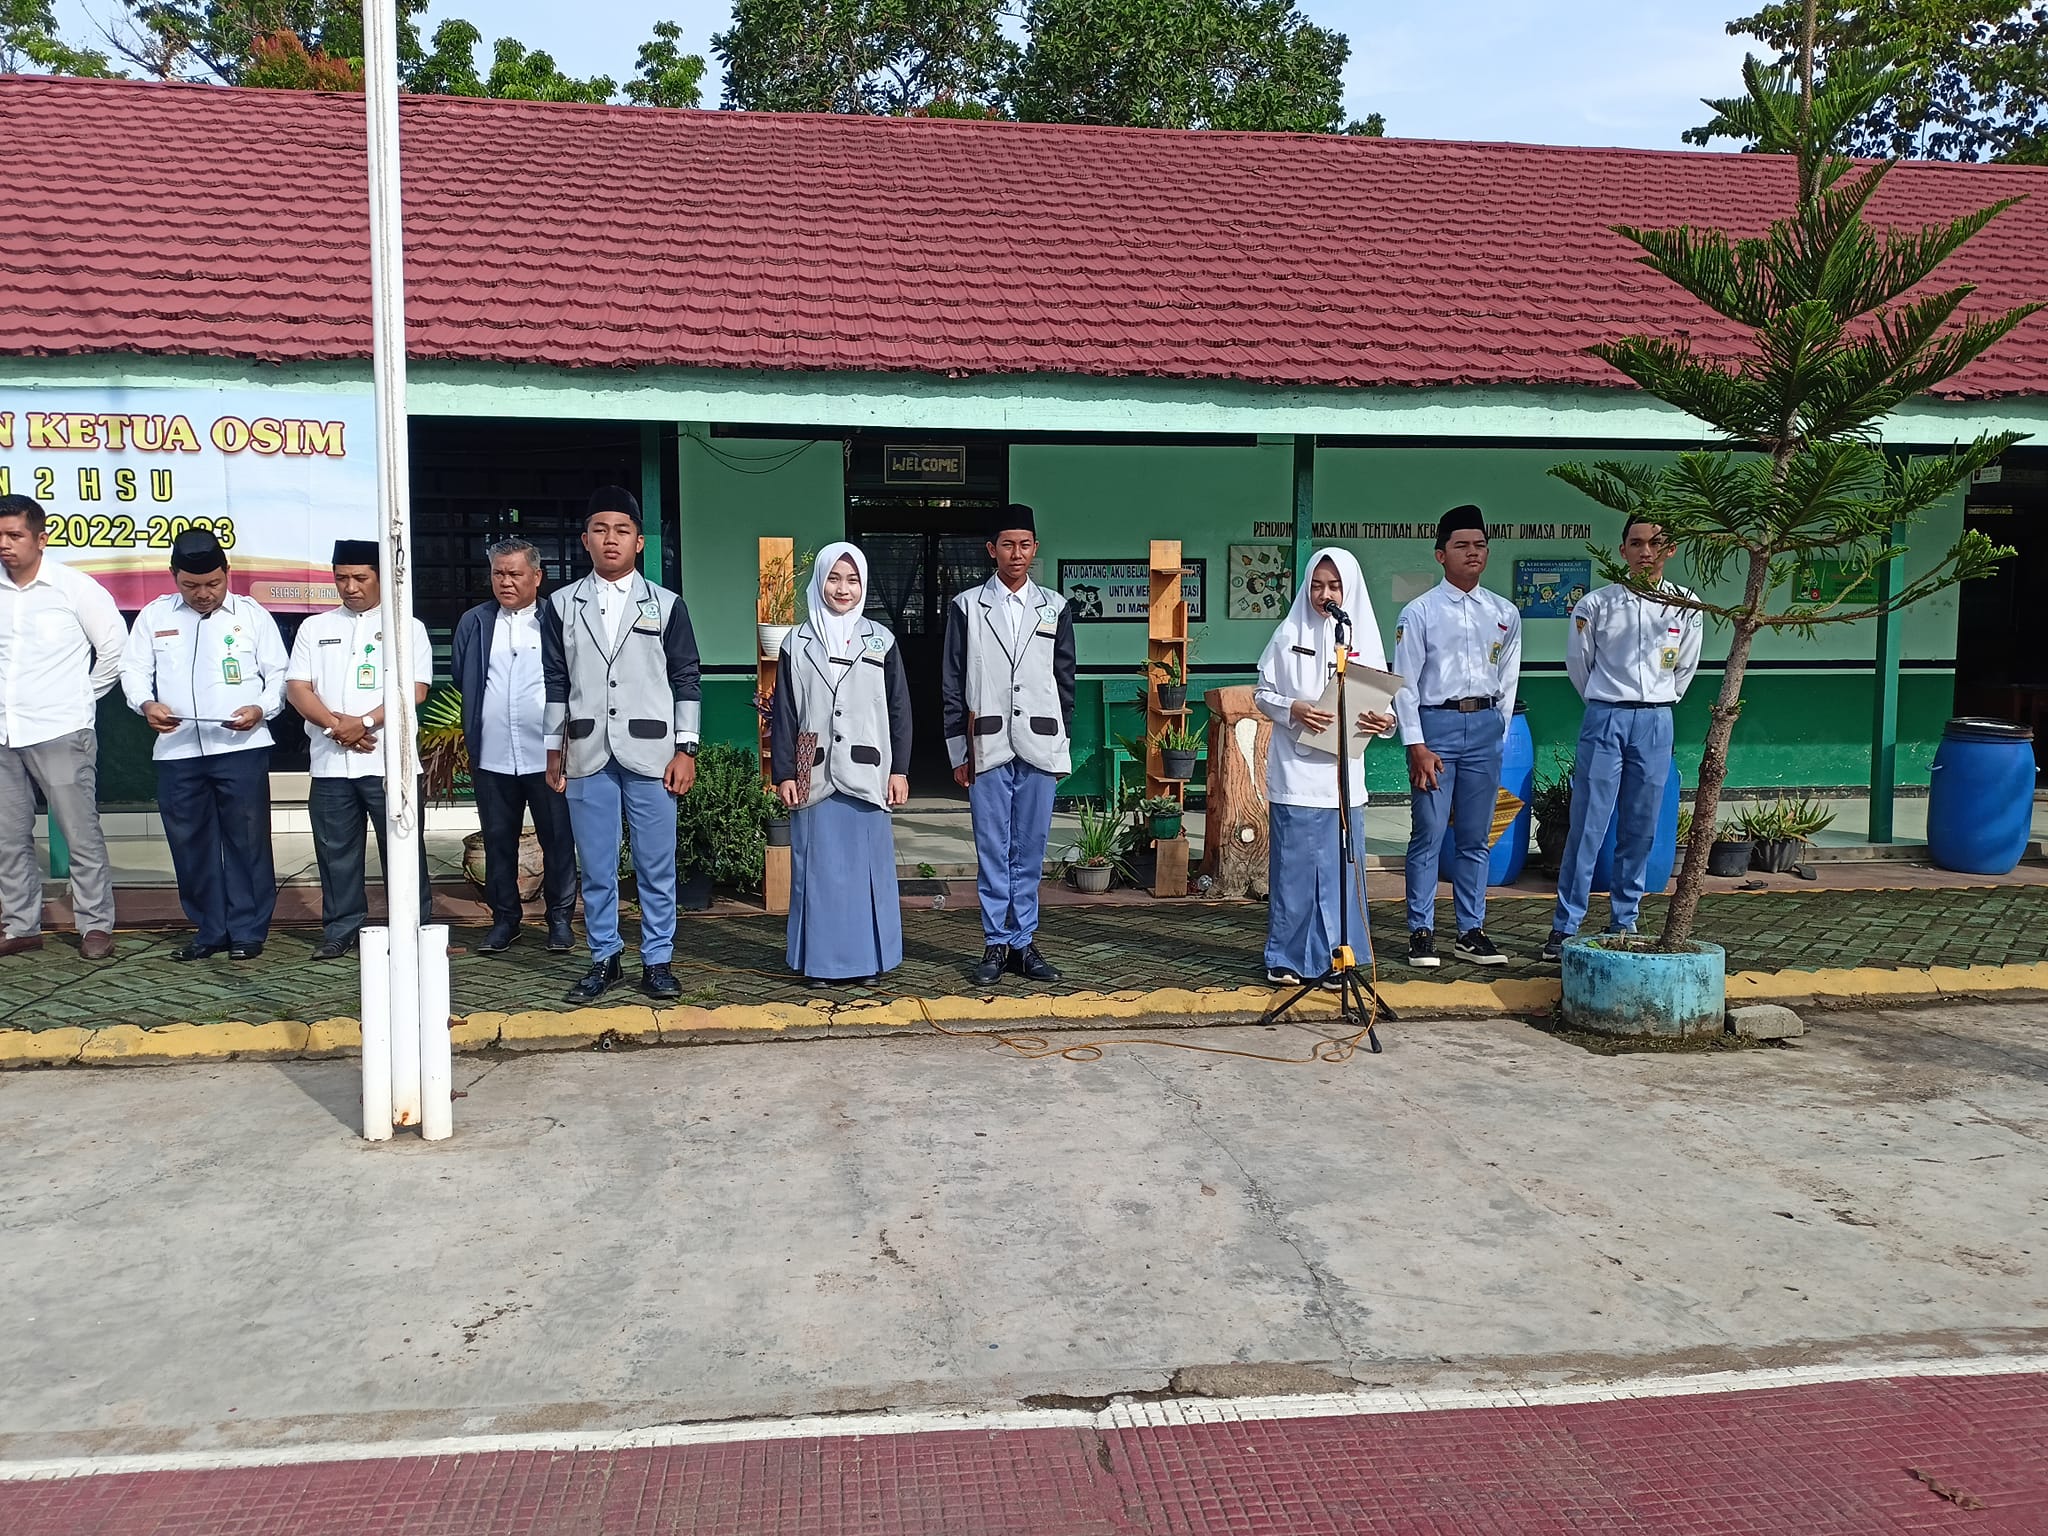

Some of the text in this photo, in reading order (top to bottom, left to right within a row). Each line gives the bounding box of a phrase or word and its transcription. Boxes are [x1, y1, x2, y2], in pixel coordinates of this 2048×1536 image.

[26, 411, 201, 451] KETUA
[210, 415, 347, 457] OSIM
[892, 457, 959, 472] WELCOME
[34, 467, 54, 500] 2
[1312, 522, 1337, 538] MASA
[1340, 522, 1358, 538] KINI
[1362, 522, 1412, 539] TENTUKAN
[1486, 523, 1514, 539] UMAT
[1519, 523, 1555, 539] DIMASA
[1561, 523, 1591, 539] DEPAN
[1063, 565, 1078, 579] AKU
[1081, 565, 1109, 580] DATANG,
[1111, 565, 1126, 579] AKU
[1109, 585, 1135, 597] UNTUK
[1117, 603, 1126, 613] DI
